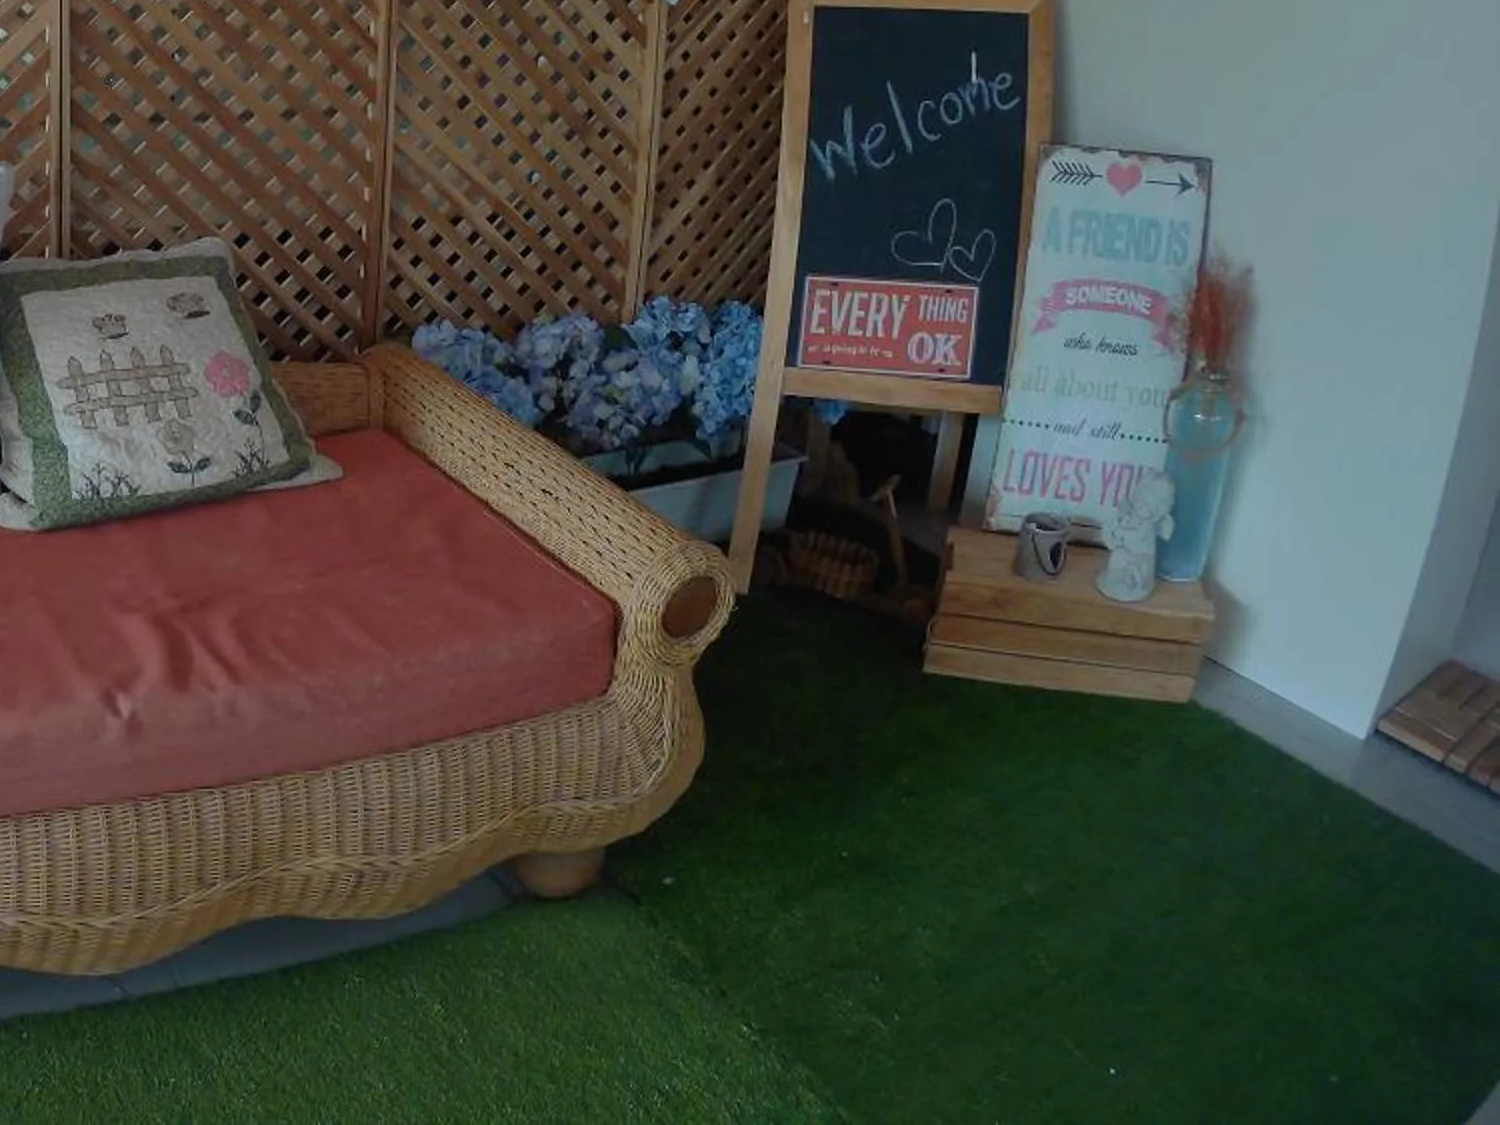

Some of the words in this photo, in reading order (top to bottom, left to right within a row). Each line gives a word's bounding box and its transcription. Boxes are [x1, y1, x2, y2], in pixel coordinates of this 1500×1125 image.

[809, 51, 1022, 180] Welcome
[1041, 206, 1062, 254] A
[1066, 207, 1164, 263] FRIEND
[1166, 218, 1191, 267] IS
[809, 287, 912, 340] EVERY
[917, 293, 970, 324] THING
[1064, 284, 1153, 316] SOMEONE
[907, 331, 963, 367] OK
[1021, 363, 1049, 393] all
[1053, 370, 1118, 403] about
[1053, 418, 1086, 438] and
[1090, 421, 1122, 441] still
[1003, 447, 1091, 503] LOVES
[1100, 460, 1144, 508] YO
